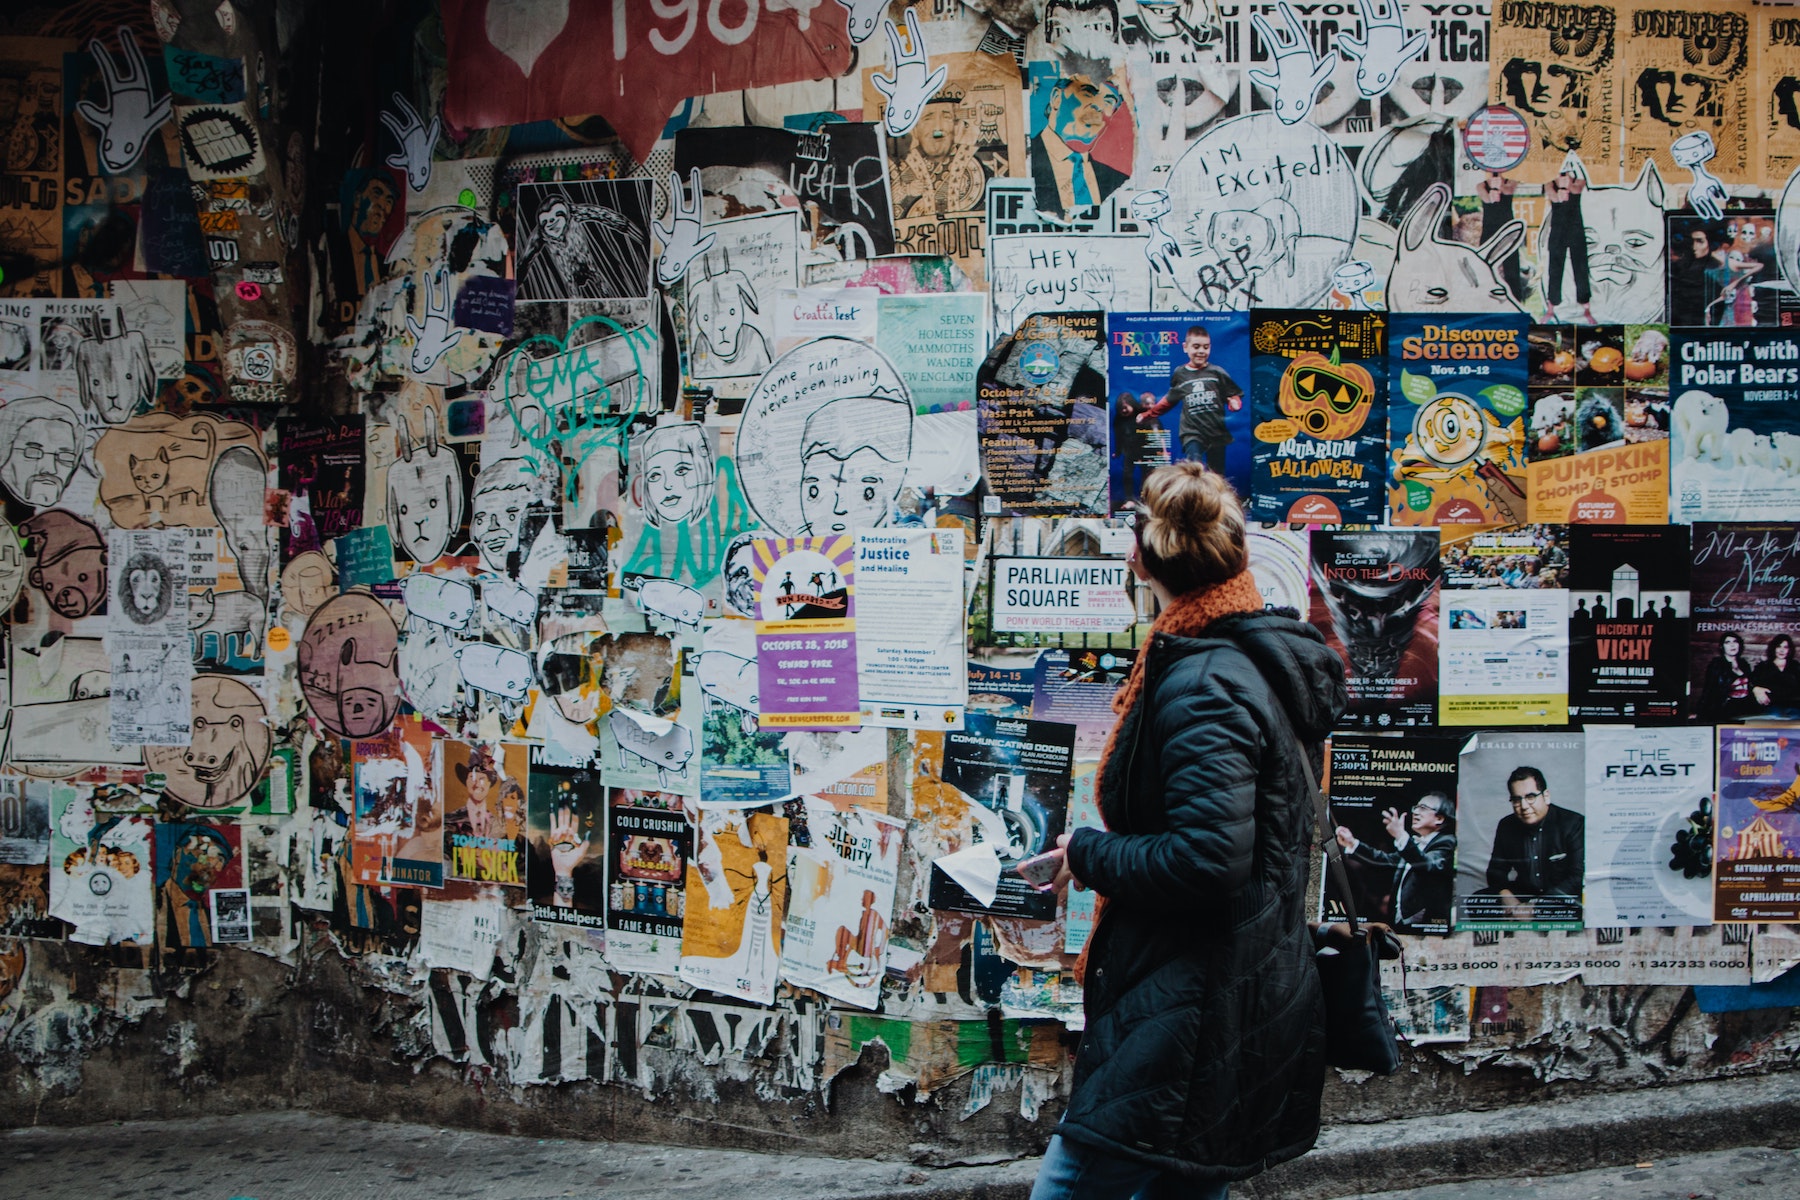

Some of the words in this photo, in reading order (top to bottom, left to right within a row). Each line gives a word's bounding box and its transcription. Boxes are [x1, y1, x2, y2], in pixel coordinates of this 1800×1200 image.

[996, 195, 1023, 219] IF
[1029, 248, 1078, 269] HEY
[940, 314, 975, 326] SEVEN
[1042, 316, 1097, 328] Bellevue
[918, 328, 975, 340] HOMELESS
[1028, 329, 1057, 340] Gem
[1061, 328, 1097, 339] Show
[1113, 331, 1180, 345] DISCOVER
[1422, 325, 1519, 342] Discover
[908, 342, 975, 354] MAMMOTHS
[1121, 344, 1170, 356] DANCE
[1402, 336, 1521, 360] Science
[1753, 341, 1799, 360] with
[808, 356, 839, 376] rain
[926, 357, 974, 368] WANDER
[922, 371, 974, 383] ENGLAND
[1430, 365, 1457, 376] Nov.
[1681, 364, 1736, 385] Polar
[1740, 363, 1799, 385] Bears
[794, 377, 828, 401] been
[980, 387, 1025, 398] October
[1027, 387, 1041, 397] 27
[1744, 389, 1783, 402] NOVEMBER
[981, 409, 1007, 419] Vasa
[1009, 408, 1035, 418] Park
[981, 437, 1036, 449] Featuring
[1276, 437, 1358, 460] AQUARIUM
[1268, 458, 1365, 480] HALLOWEEN
[1536, 446, 1662, 486] PUMPKIN
[1536, 482, 1589, 503] CHOMP
[1610, 469, 1662, 488] STOMP
[1577, 501, 1616, 510] SATURDAY
[1577, 509, 1601, 519] OCT
[1602, 509, 1616, 519] 27
[860, 535, 908, 544] Restorative
[860, 547, 911, 560] Justice
[860, 564, 876, 572] and
[877, 564, 908, 575] Healing
[1008, 567, 1125, 585] PARLIAMENT
[1322, 562, 1358, 581] INTO
[1360, 568, 1382, 580] THE
[1387, 562, 1431, 582] DARK
[1007, 589, 1080, 607] SQUARE
[1006, 616, 1030, 626] PONY
[1031, 616, 1062, 627] WORLD
[1064, 617, 1102, 627] THEATRE
[1596, 623, 1640, 636] INCIDENT
[1641, 624, 1654, 636] AT
[761, 640, 804, 651] OCTOBER
[805, 640, 821, 652] 28,
[823, 639, 849, 650] 2018
[1596, 638, 1653, 661] VICHY
[811, 660, 834, 669] PARK
[989, 671, 1001, 680] 14
[1009, 671, 1022, 682] 15
[1599, 666, 1627, 677] ARTHUR
[1627, 667, 1655, 677] MILLER
[1374, 677, 1412, 686] NOVEMBER
[950, 733, 1034, 751] COMMUNICATING
[1034, 743, 1070, 755] DOORS
[1518, 741, 1543, 750] CITY
[1546, 741, 1580, 750] MUSIC
[1333, 753, 1358, 761] NOV
[1371, 749, 1416, 760] TAIWAN
[1623, 748, 1671, 761] THE
[1333, 761, 1369, 771] 7:30PM
[1370, 761, 1457, 773] PHILHARMONIC
[1606, 763, 1696, 778] FEAST
[616, 815, 641, 829] COLD
[451, 834, 494, 849] TOUCH
[496, 837, 516, 851] ME
[452, 847, 477, 879] I'M
[481, 850, 520, 884] SICK
[473, 915, 490, 931] MAY
[558, 907, 603, 927] Helpers
[618, 918, 643, 933] FAME
[645, 922, 652, 934] &
[655, 924, 684, 938] GLORY
[1461, 961, 1498, 970] 6000
[1585, 959, 1621, 968] 6000
[1708, 959, 1746, 969] 6000
